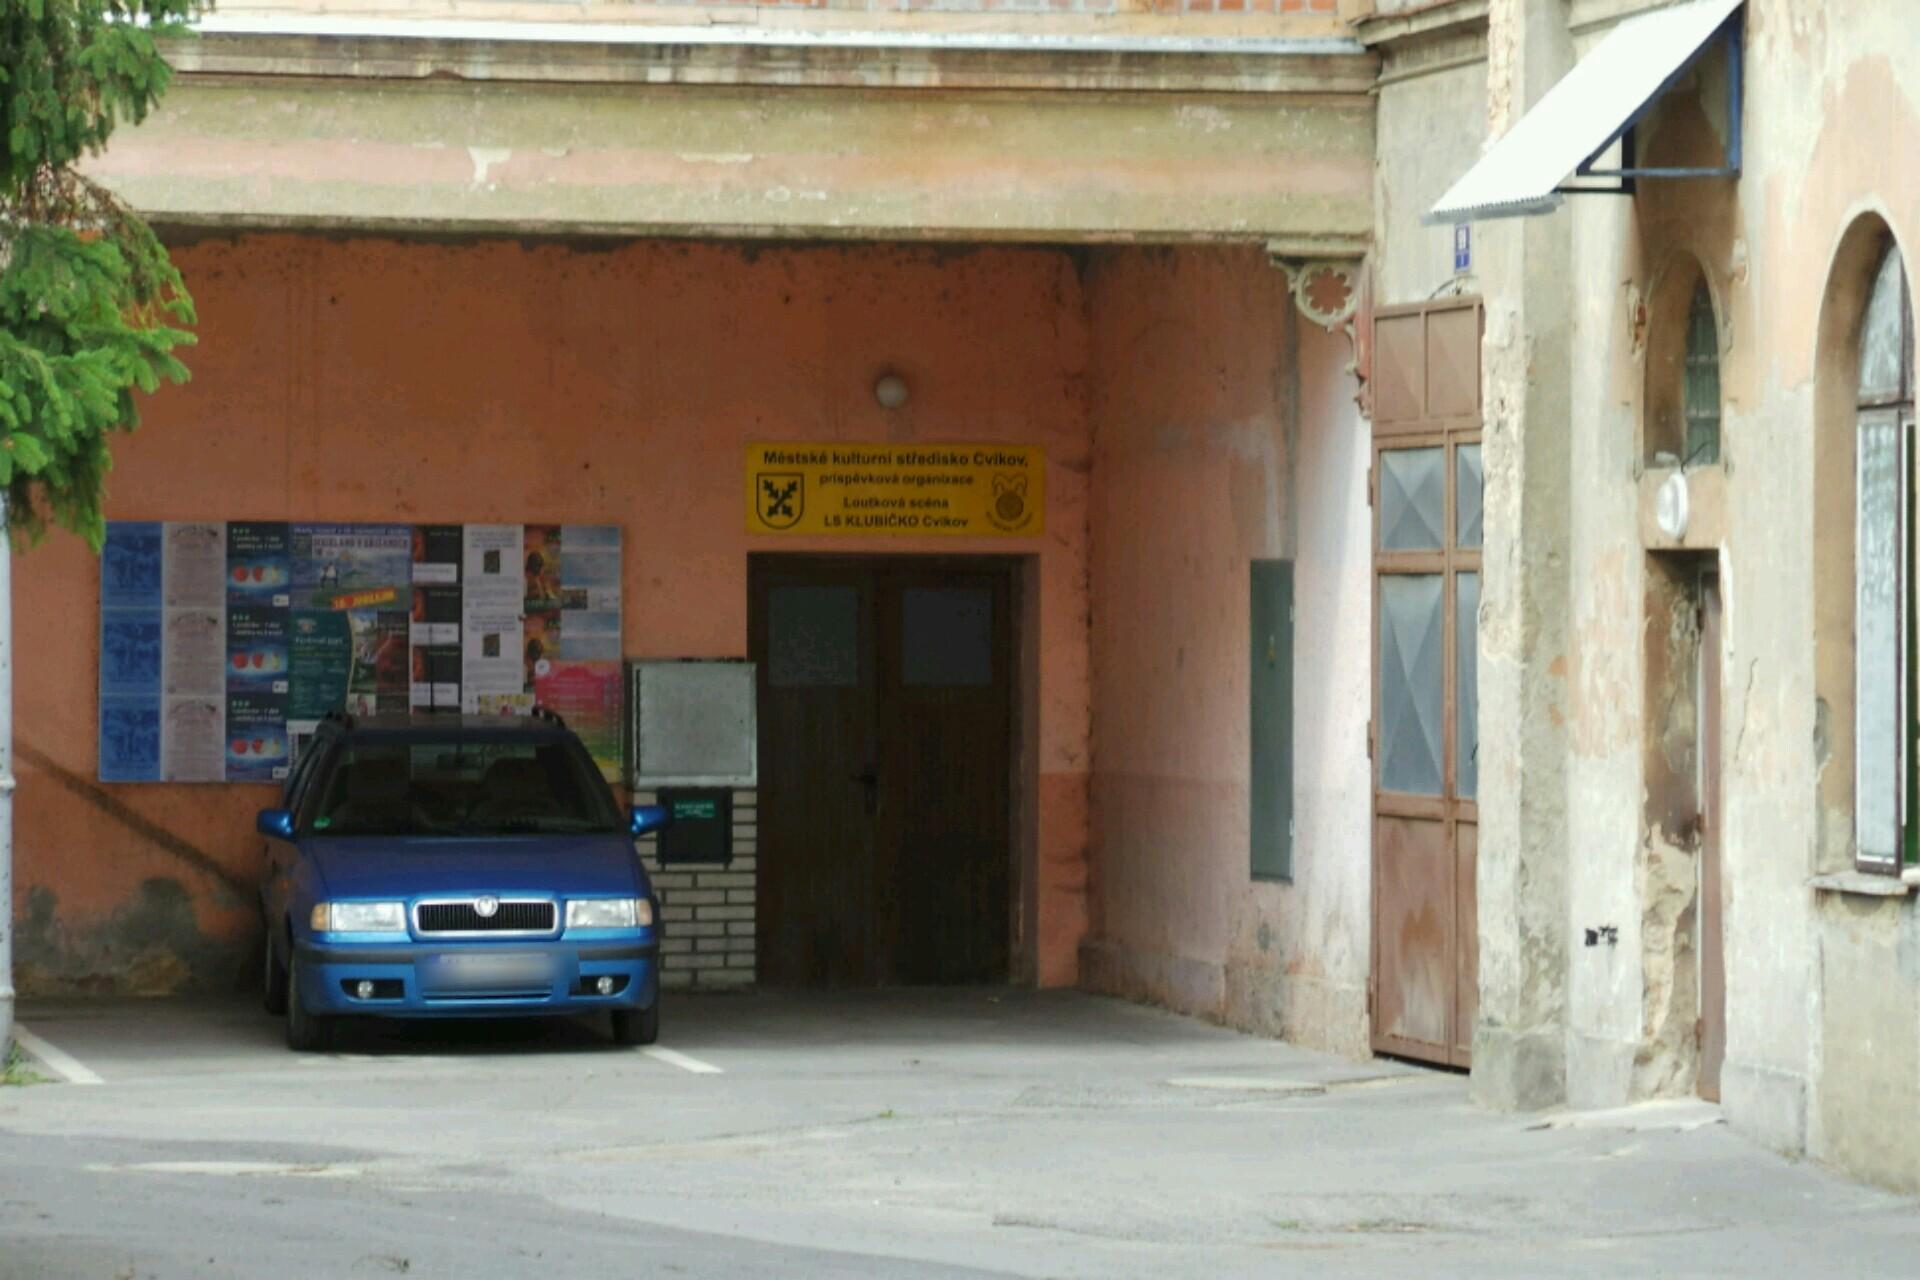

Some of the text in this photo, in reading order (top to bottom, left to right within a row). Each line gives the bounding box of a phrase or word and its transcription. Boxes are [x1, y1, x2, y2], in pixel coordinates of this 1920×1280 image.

[764, 450, 828, 465] Městské
[832, 451, 892, 465] kulturní
[896, 451, 969, 465] středisko
[902, 473, 975, 487] organizace
[843, 496, 949, 509] Loutková scéna
[922, 515, 969, 527] Cvikov
